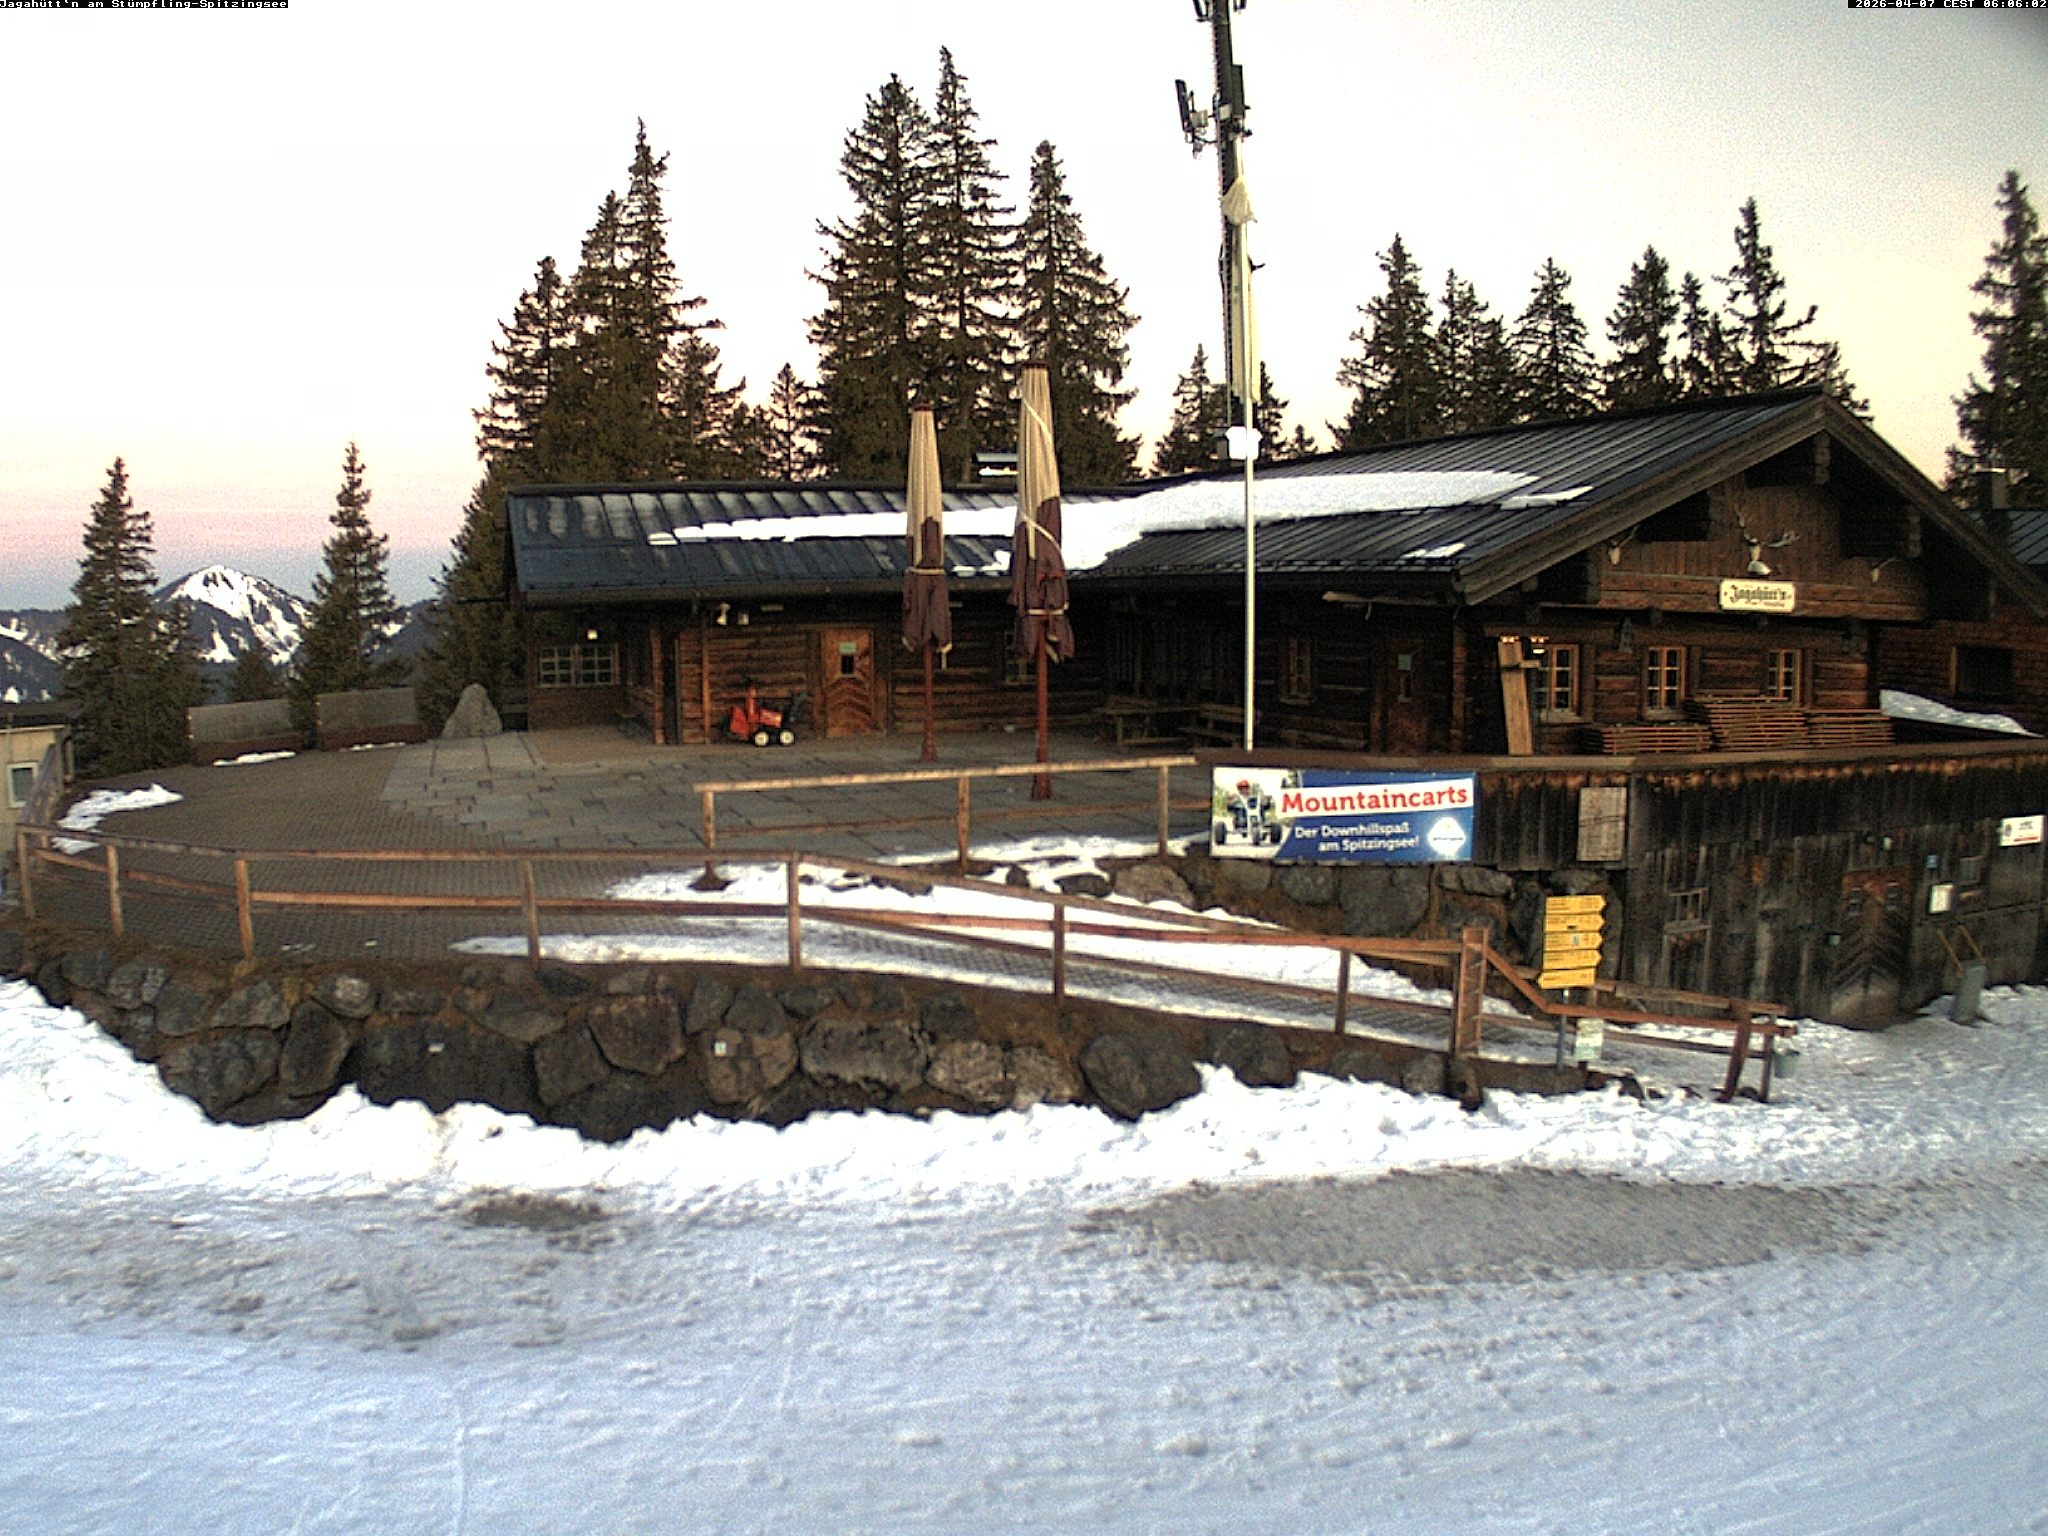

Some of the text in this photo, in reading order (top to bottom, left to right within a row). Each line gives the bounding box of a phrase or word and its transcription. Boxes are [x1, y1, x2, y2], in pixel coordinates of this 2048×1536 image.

[1281, 786, 1469, 813] Mountaincarts
[1295, 823, 1410, 838] Der Downhillspaß
[1318, 841, 1340, 852] am
[1342, 837, 1419, 852] Spitzingsee!
